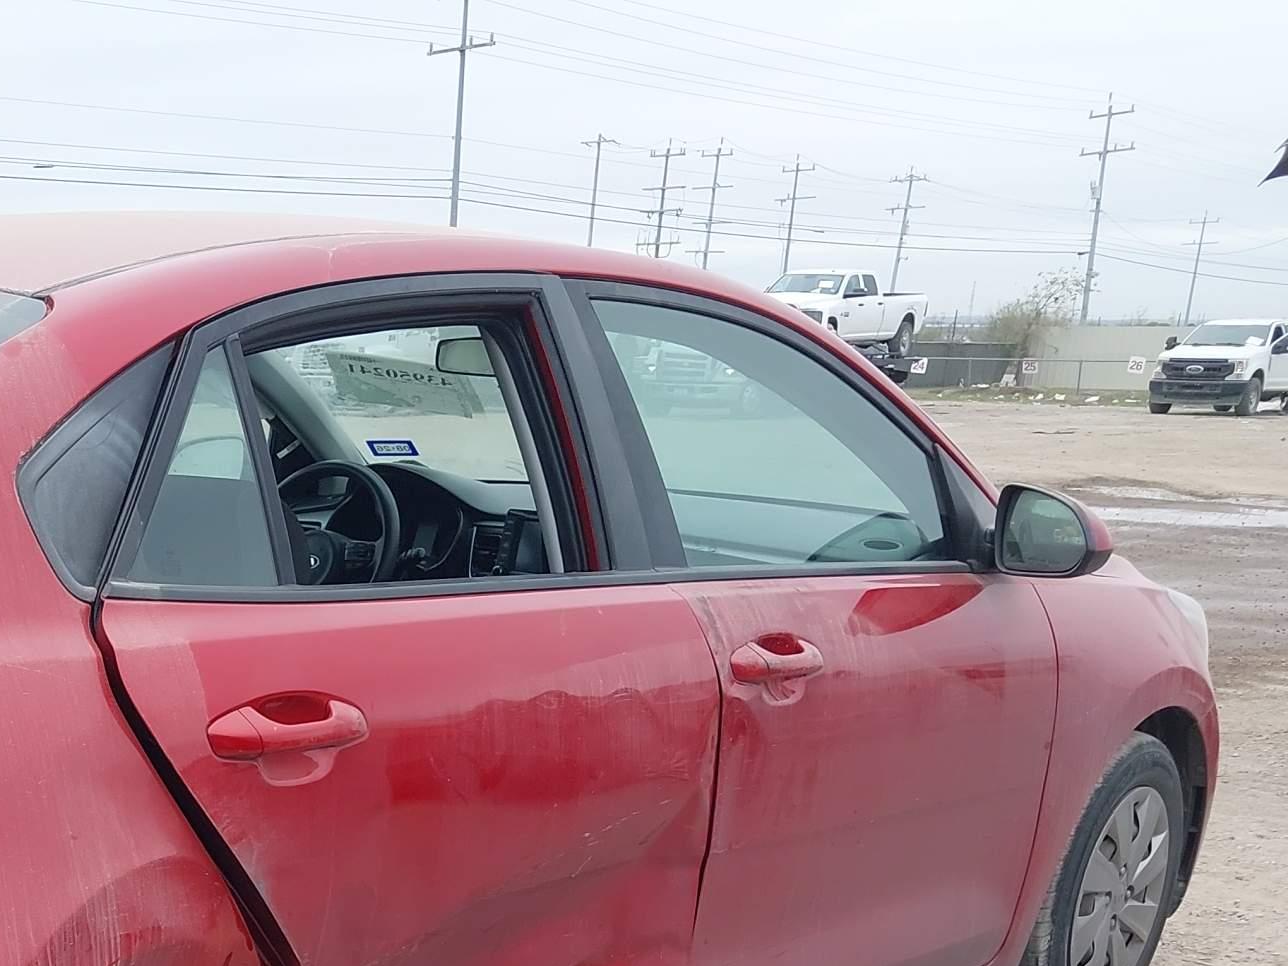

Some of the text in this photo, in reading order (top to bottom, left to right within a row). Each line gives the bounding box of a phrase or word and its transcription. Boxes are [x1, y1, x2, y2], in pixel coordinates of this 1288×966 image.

[912, 360, 925, 371] 24
[1023, 361, 1037, 371] 25
[1128, 360, 1143, 371] 26
